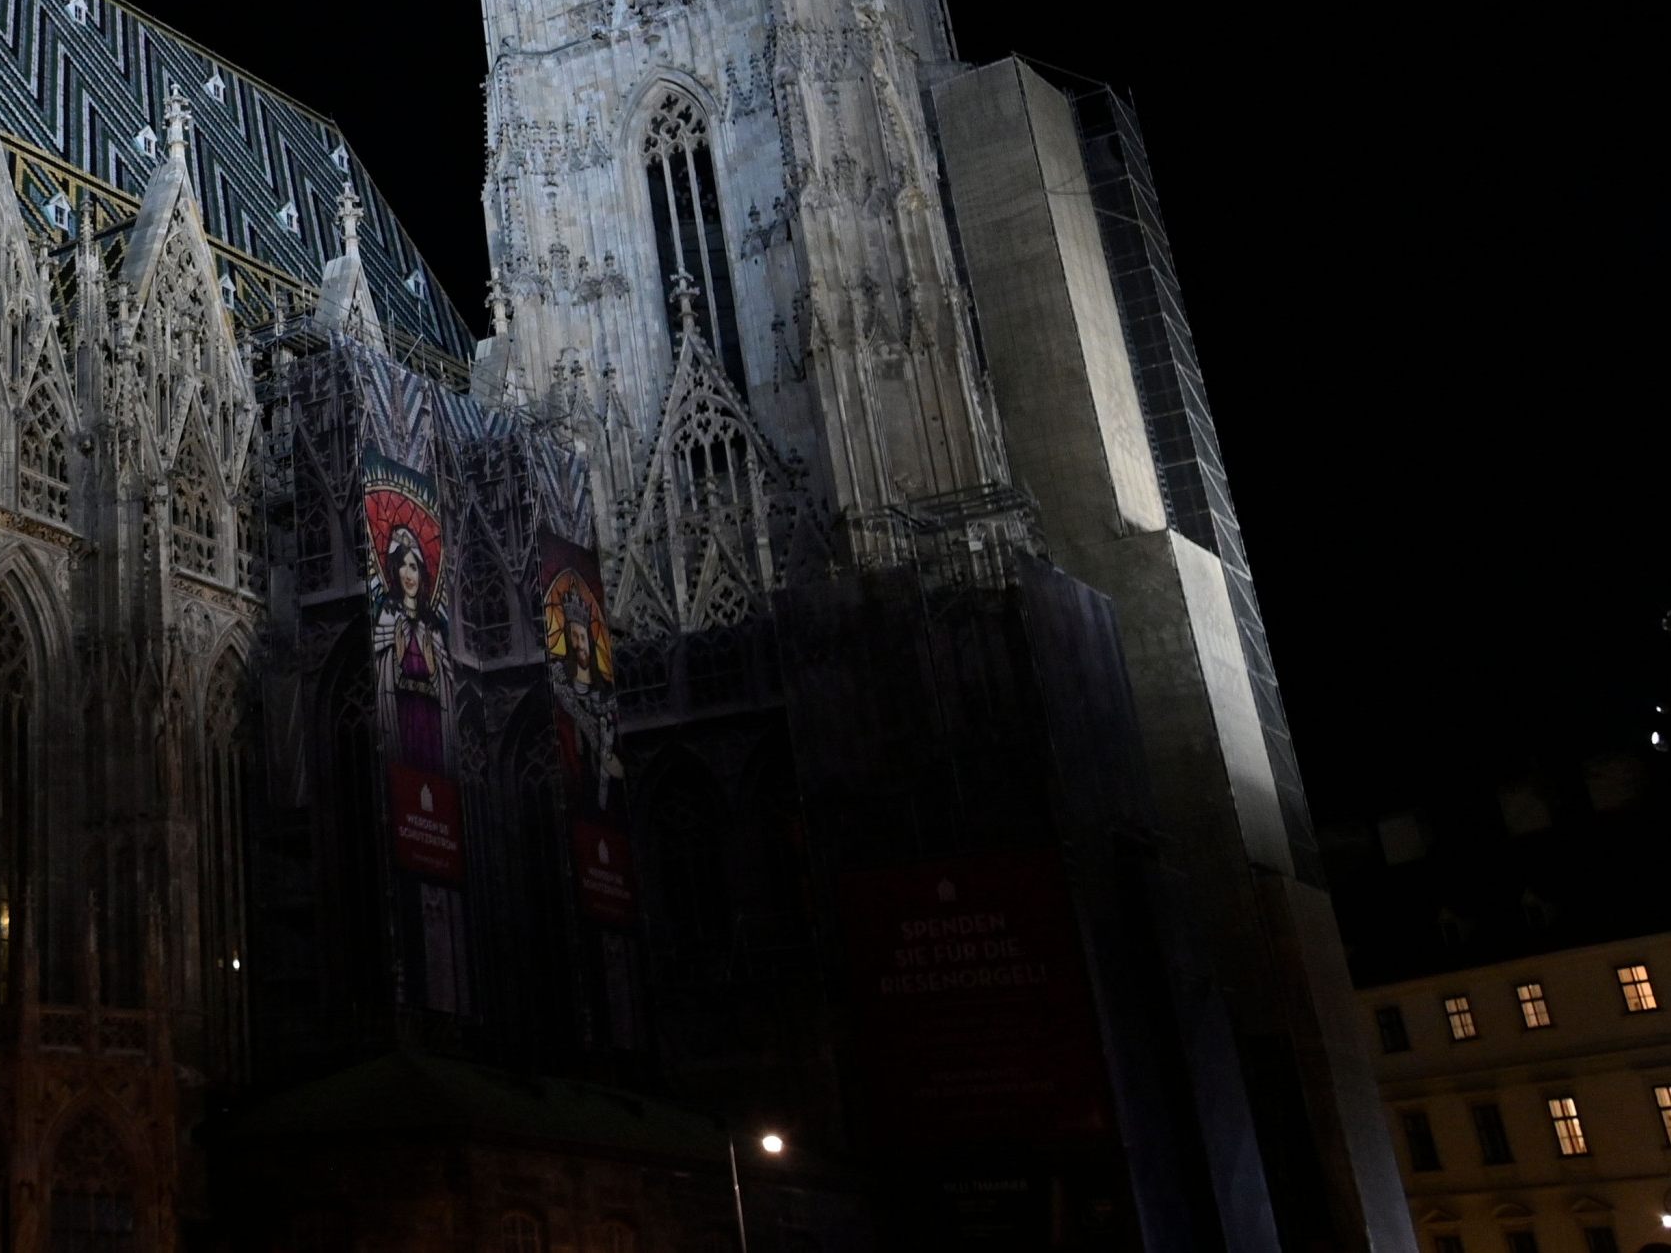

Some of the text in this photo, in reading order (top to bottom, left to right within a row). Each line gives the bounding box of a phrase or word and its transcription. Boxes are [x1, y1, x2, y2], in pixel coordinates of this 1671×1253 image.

[899, 911, 1007, 941] SPENDEN
[893, 936, 1024, 969] SIE FÜR DIE
[879, 962, 1049, 995] RIESENORGEL!
